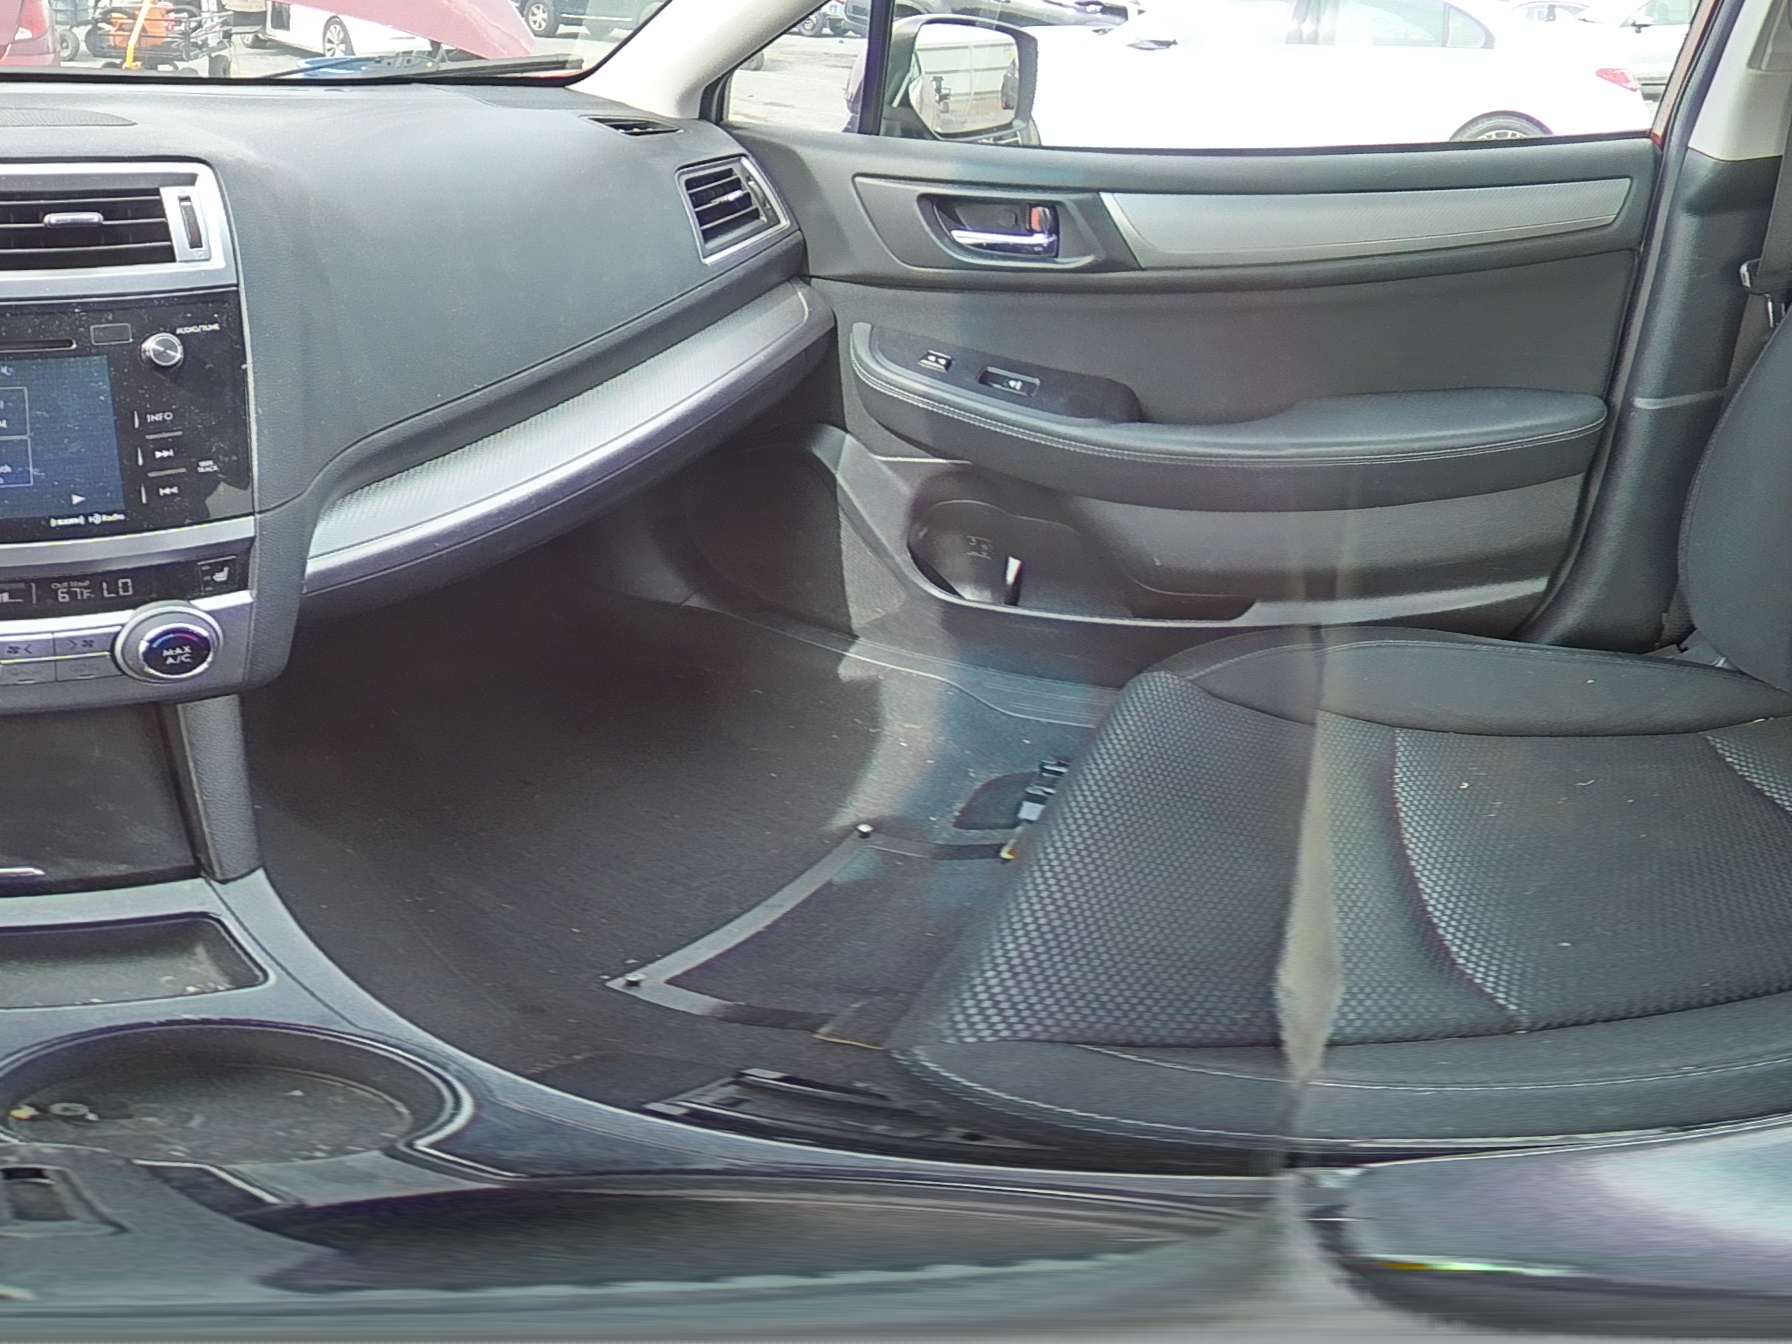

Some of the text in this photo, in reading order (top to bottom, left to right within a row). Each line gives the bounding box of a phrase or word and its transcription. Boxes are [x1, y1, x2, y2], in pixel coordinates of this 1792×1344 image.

[147, 412, 173, 423] INFO
[102, 578, 133, 597] LO
[163, 646, 192, 657] MAX
[166, 655, 192, 665] A/C
